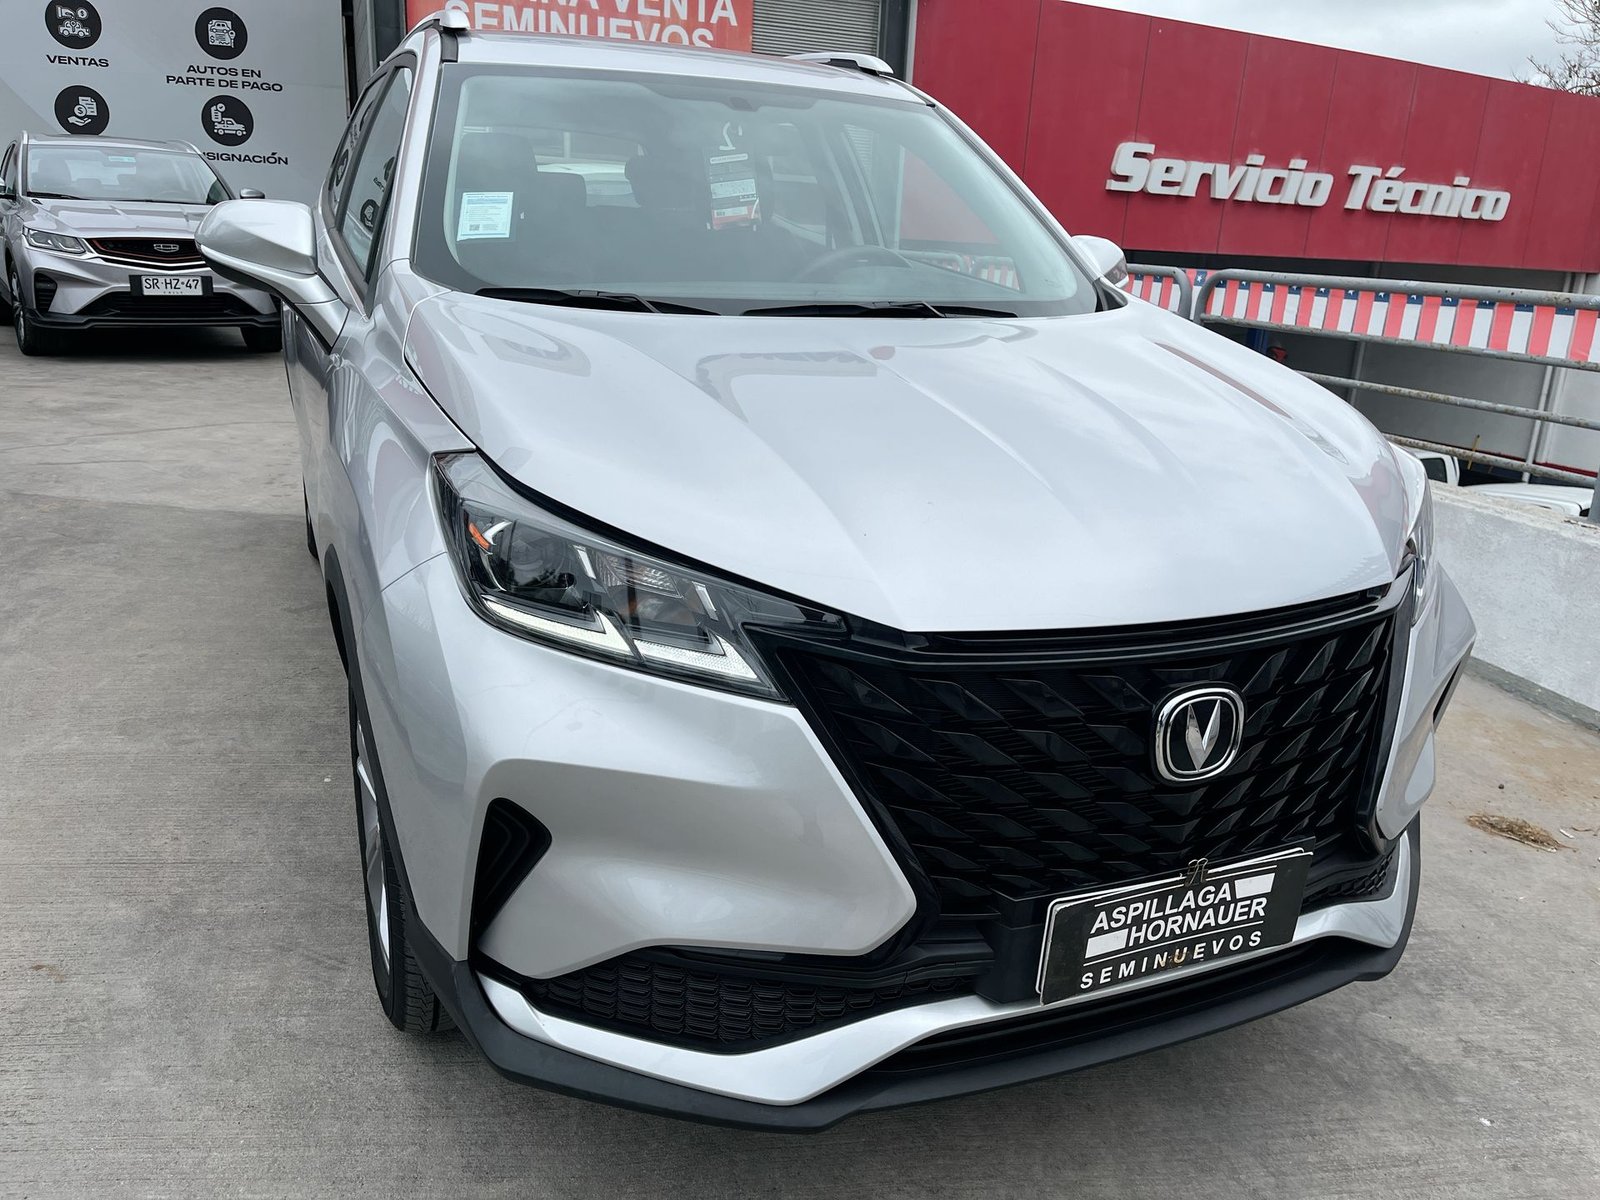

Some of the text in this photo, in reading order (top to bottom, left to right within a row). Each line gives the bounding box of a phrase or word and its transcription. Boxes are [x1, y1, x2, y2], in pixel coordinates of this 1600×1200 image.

[46, 54, 109, 68] VENTAS
[186, 64, 261, 78] AUTOS EN
[166, 75, 283, 92] PARTE DE PAGO
[203, 151, 288, 165] SIGNACIÓN
[1106, 141, 1511, 222] Servicio Técnico
[1089, 882, 1232, 935] ASPILLAGA
[1128, 897, 1268, 947] HORNAUER
[1079, 930, 1263, 990] SEMINUEVOS
